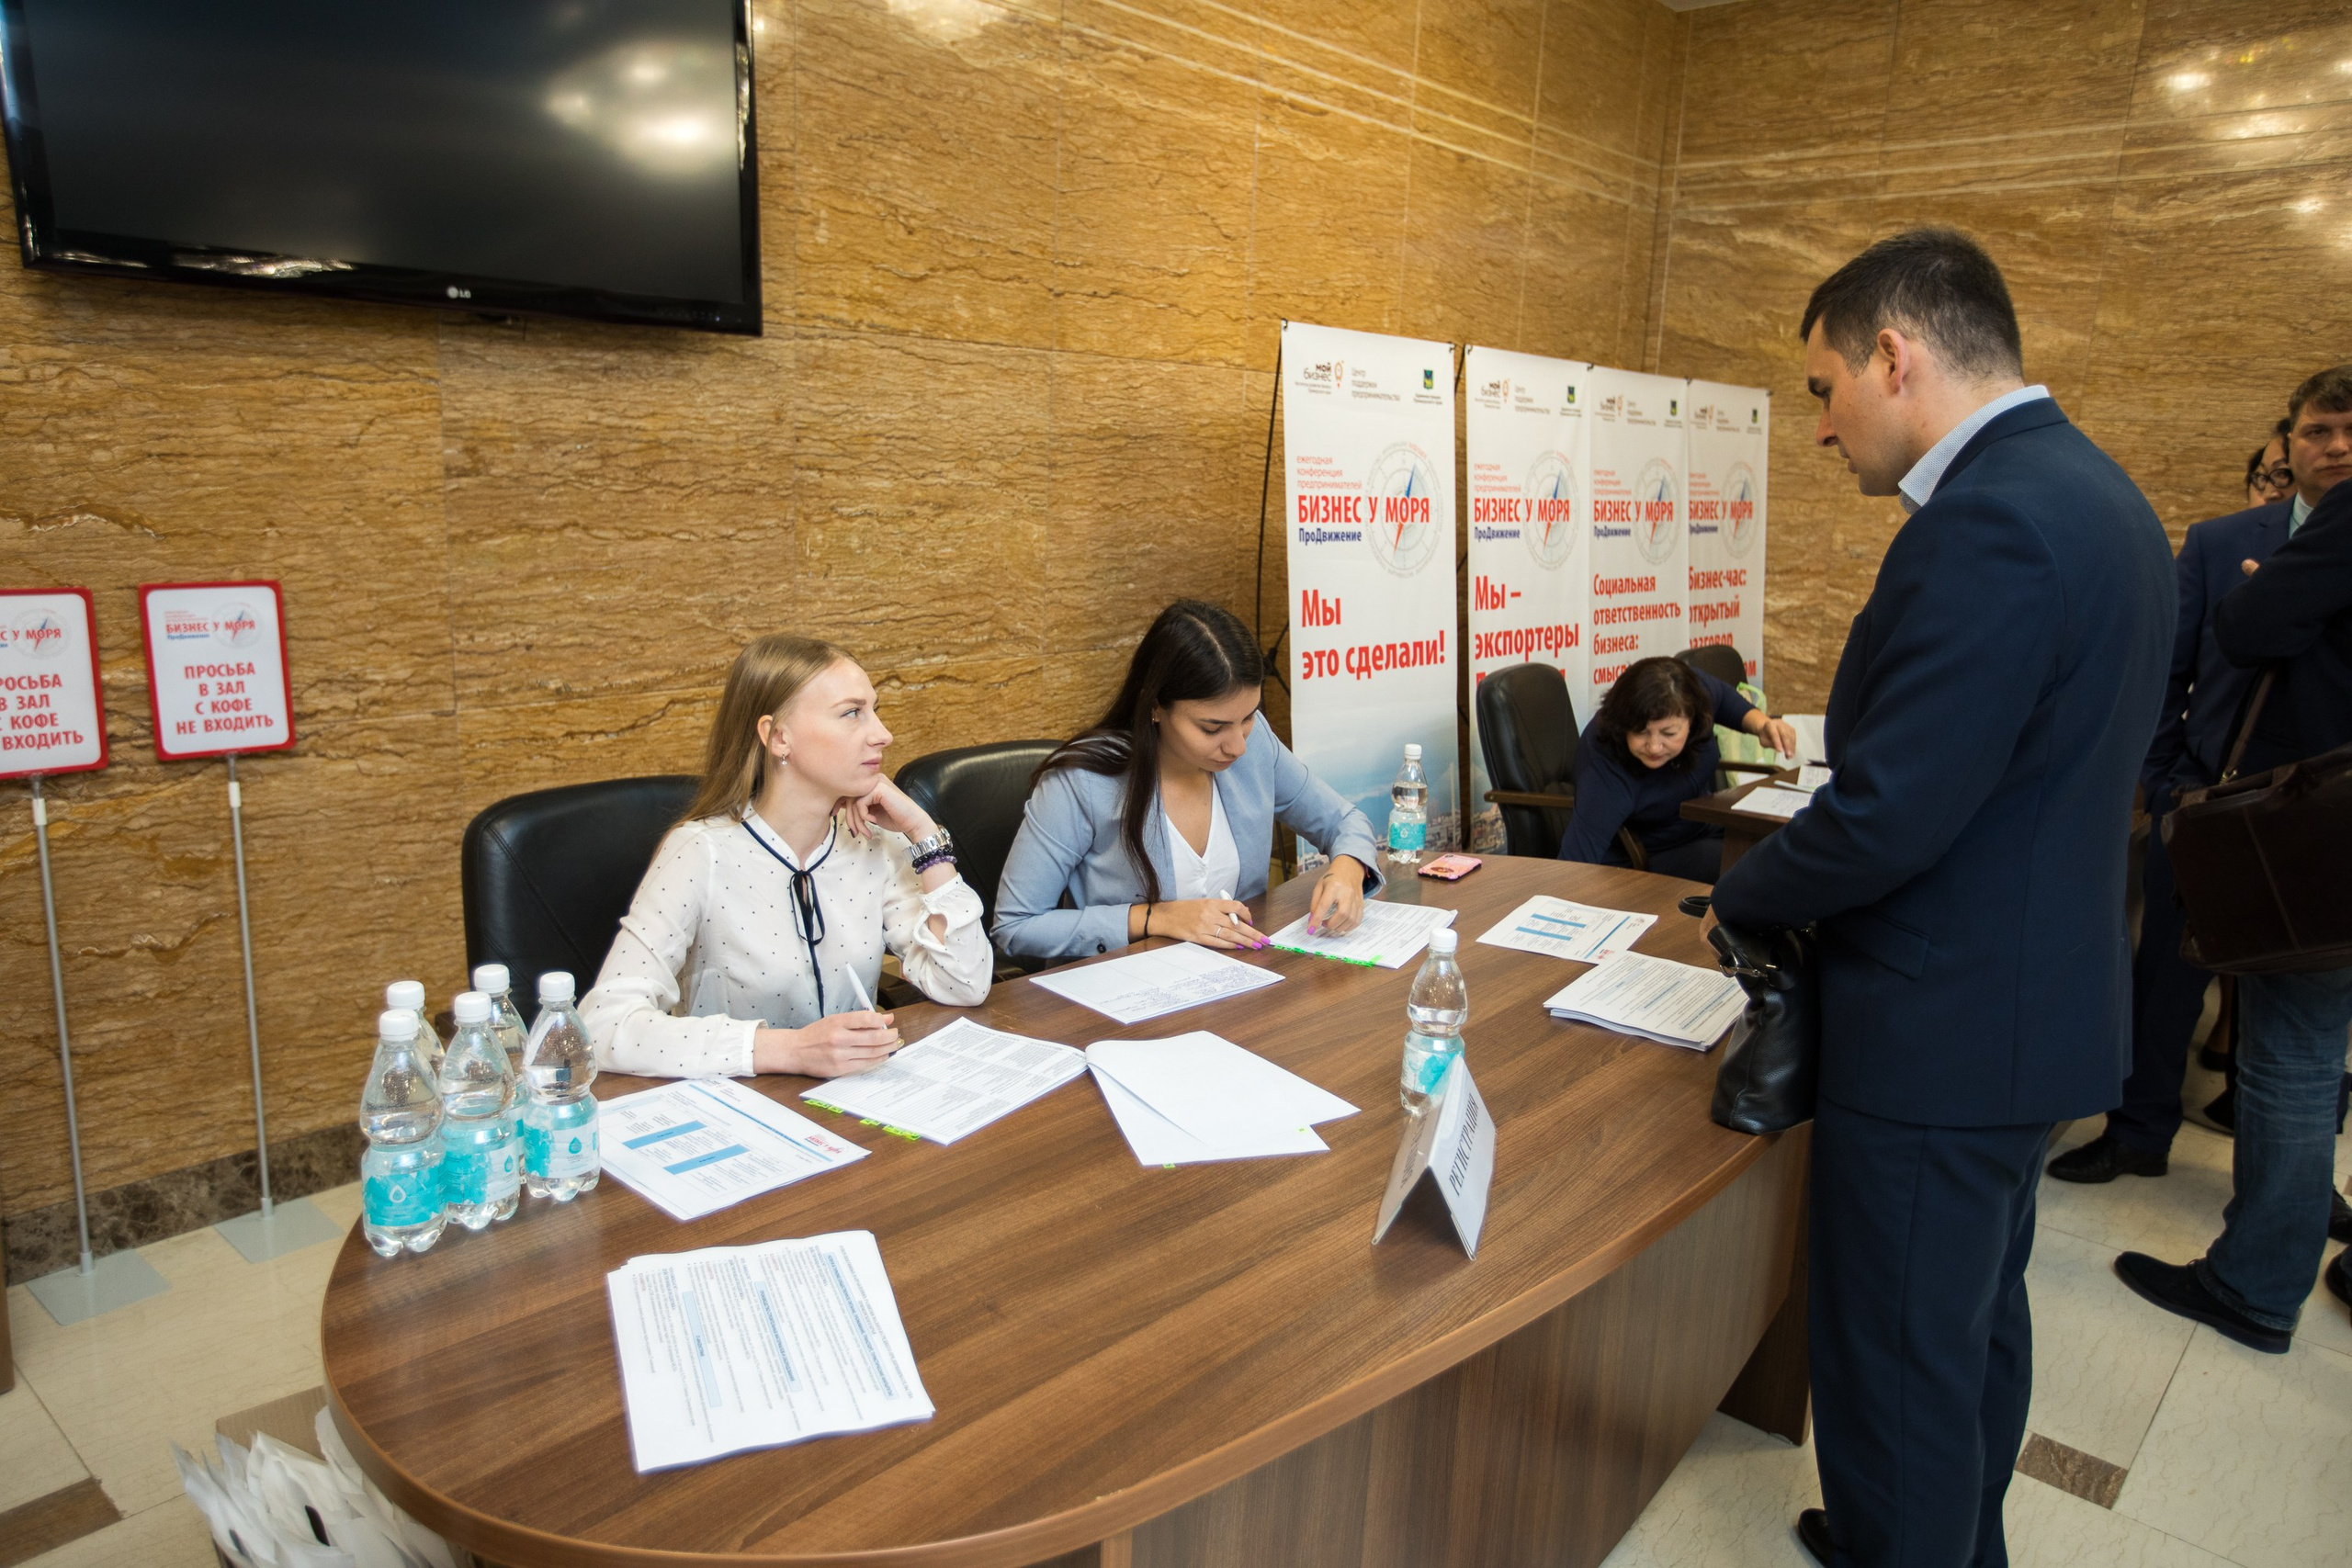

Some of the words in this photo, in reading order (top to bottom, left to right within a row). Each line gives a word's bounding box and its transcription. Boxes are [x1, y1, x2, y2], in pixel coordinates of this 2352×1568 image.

[459, 289, 471, 299] LG
[1304, 367, 1331, 381] бизнес
[1316, 362, 1331, 372] мой
[1296, 456, 1333, 466] ежегодная
[1296, 467, 1342, 478] конференция
[1297, 479, 1363, 491] предпринимателей
[1298, 495, 1362, 524] БИЗНЕС
[1369, 496, 1378, 524] У
[1385, 496, 1430, 524] МОРЯ
[1474, 498, 1521, 523] БИЗНЕС
[1525, 499, 1532, 523] У
[1538, 499, 1570, 523] МОРЯ
[1593, 500, 1632, 522] БИЗНЕС
[1634, 501, 1642, 522] У
[1645, 501, 1673, 522] МОРЯ
[1722, 501, 1727, 520] У
[1299, 527, 1362, 546] ПроДвижение
[1474, 525, 1521, 543] ПроДвижение
[1475, 575, 1506, 611] Мы
[1593, 573, 1656, 598] Социальная
[1301, 589, 1341, 627] Мы
[1593, 602, 1681, 626] ответственность
[12, 630, 20, 640] У
[26, 628, 62, 640] МОРЯ
[165, 622, 209, 634] БИЗНЕС
[212, 621, 220, 632] У
[224, 620, 255, 631] МОРЯ
[1475, 623, 1579, 663] экспортеры
[1593, 633, 1639, 656] бизнеса:
[1302, 649, 1340, 680] это
[1345, 630, 1445, 681] сделали!
[185, 661, 256, 680] ПРОСЬБА
[198, 682, 209, 697] В
[216, 681, 245, 696] ЗАЛ
[17, 694, 51, 710] ЗАЛ
[195, 701, 205, 715] С
[210, 697, 253, 714] КОФЕ
[10, 712, 60, 730] КОФЕ
[175, 720, 198, 736] НЕ
[204, 714, 275, 733] ВХОДИТЬ
[2, 729, 85, 751] ВХОДИТЬ
[1448, 1092, 1480, 1197] РЕГИСТРАЦИЯ
